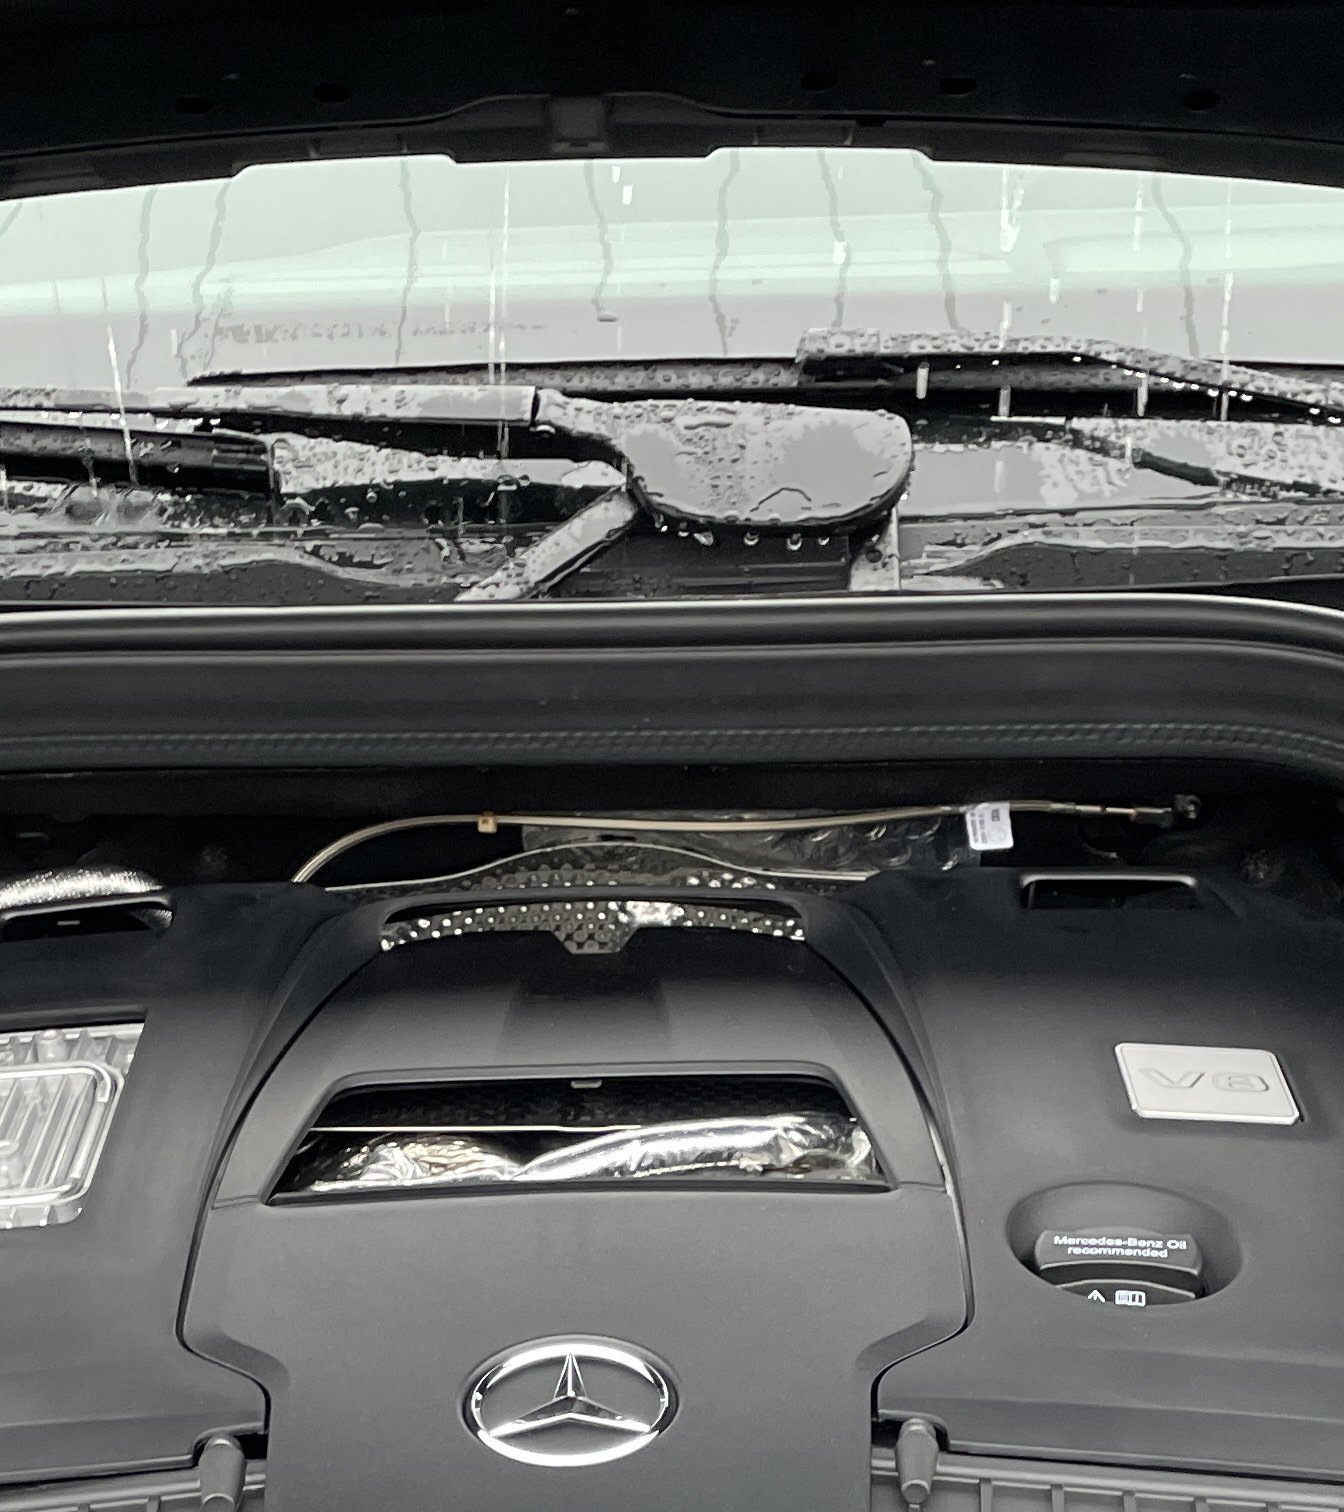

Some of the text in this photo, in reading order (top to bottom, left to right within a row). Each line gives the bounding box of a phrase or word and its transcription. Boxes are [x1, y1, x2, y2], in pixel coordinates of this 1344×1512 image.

[1053, 1235, 1187, 1250] Mercedes-Benz Oil
[1067, 1245, 1168, 1258] recommended
